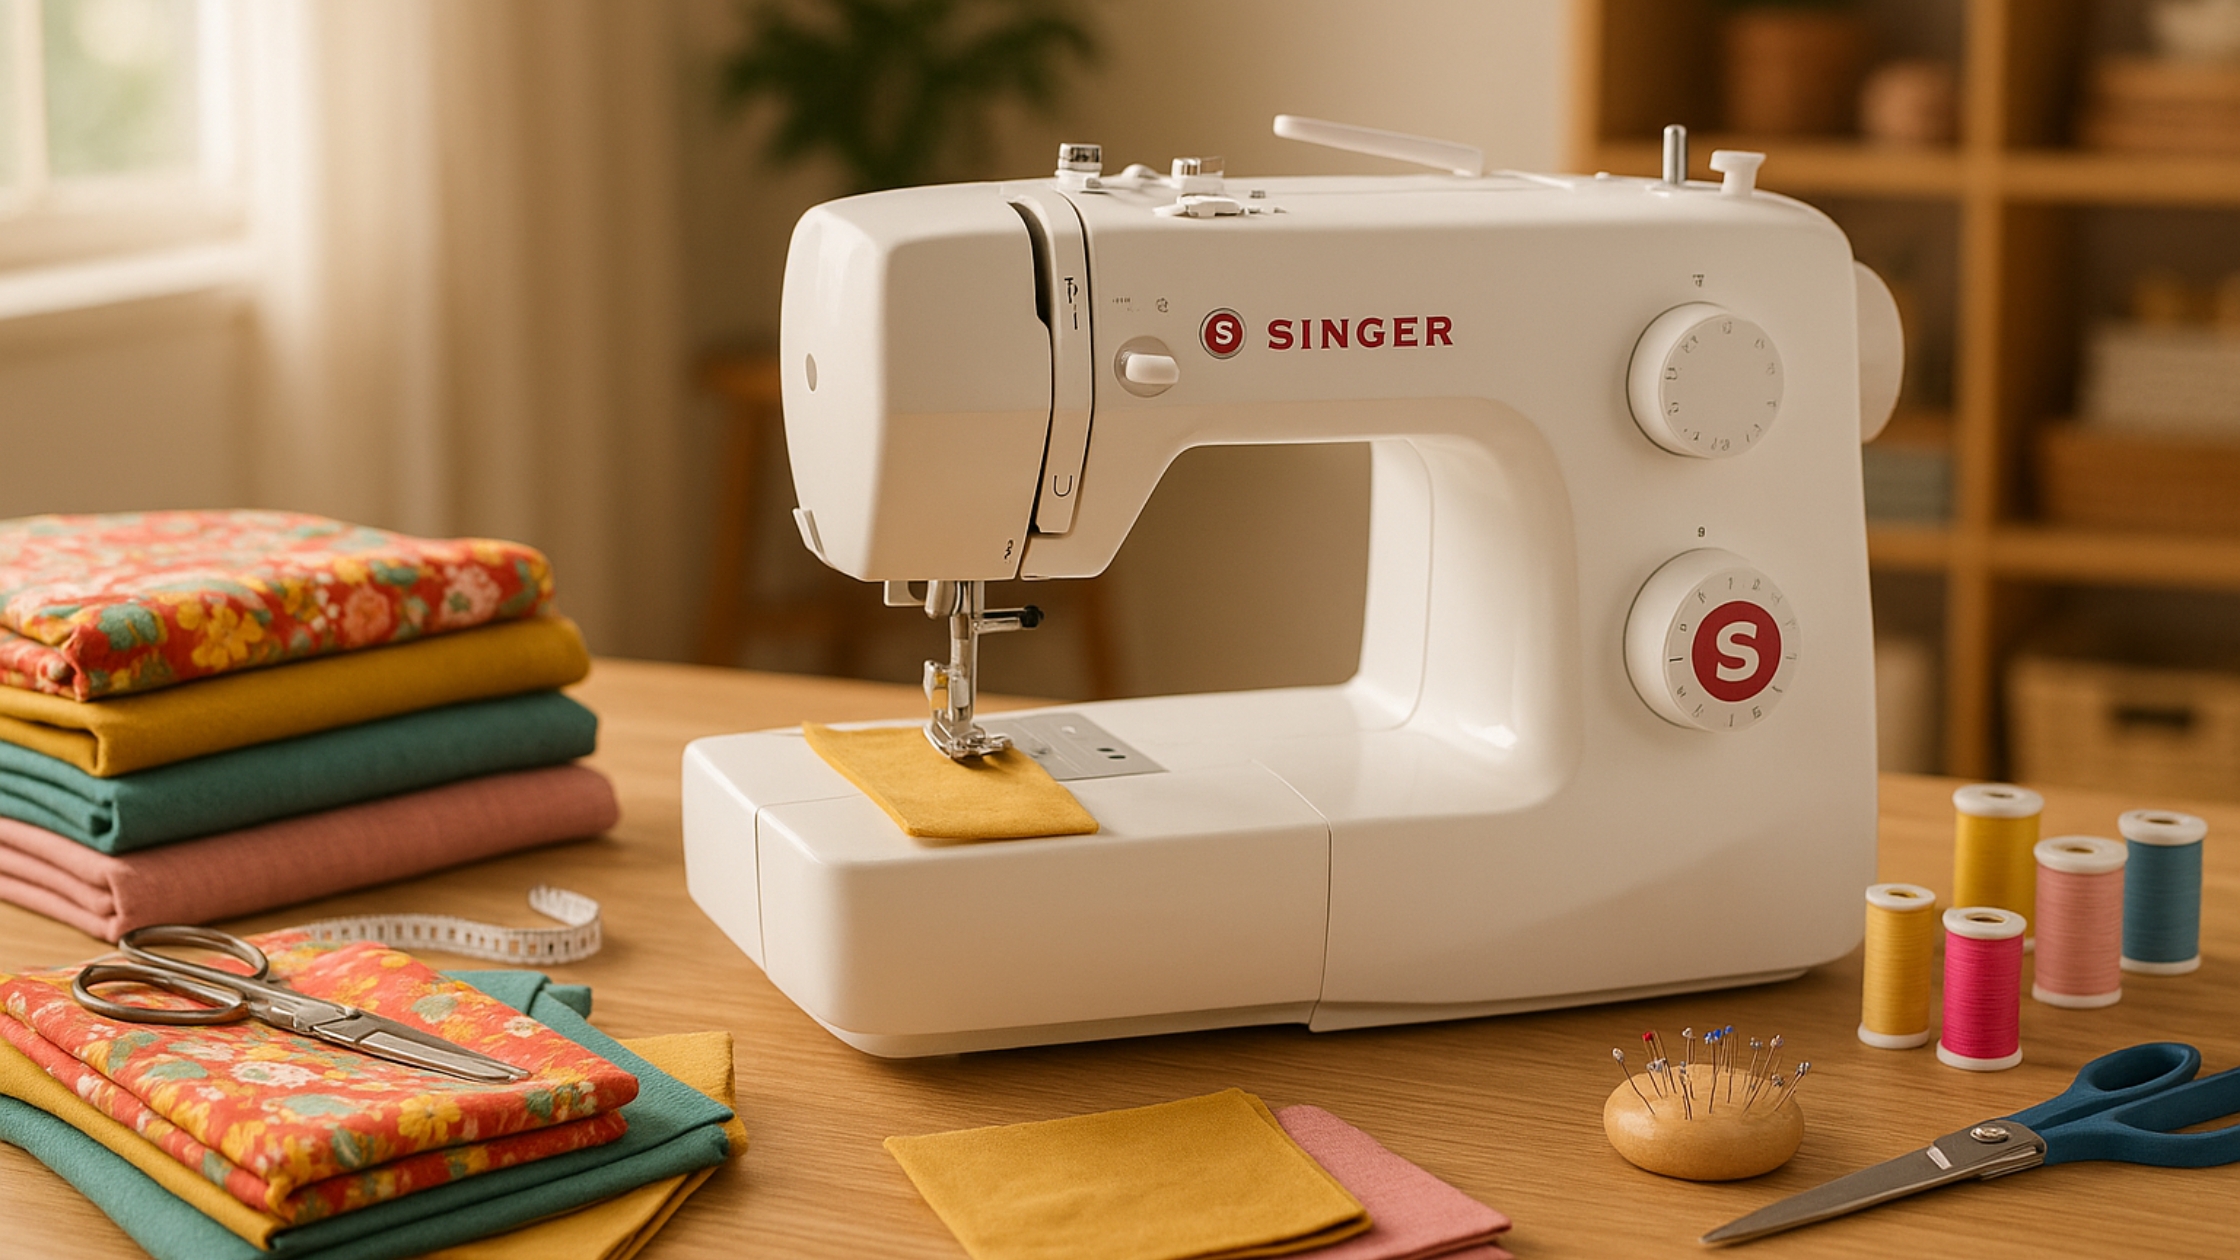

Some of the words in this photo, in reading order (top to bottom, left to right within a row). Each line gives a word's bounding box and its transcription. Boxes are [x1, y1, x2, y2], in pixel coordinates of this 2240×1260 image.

[1215, 321, 1233, 346] S
[1268, 316, 1453, 350] SINGER
[1716, 620, 1760, 682] S
